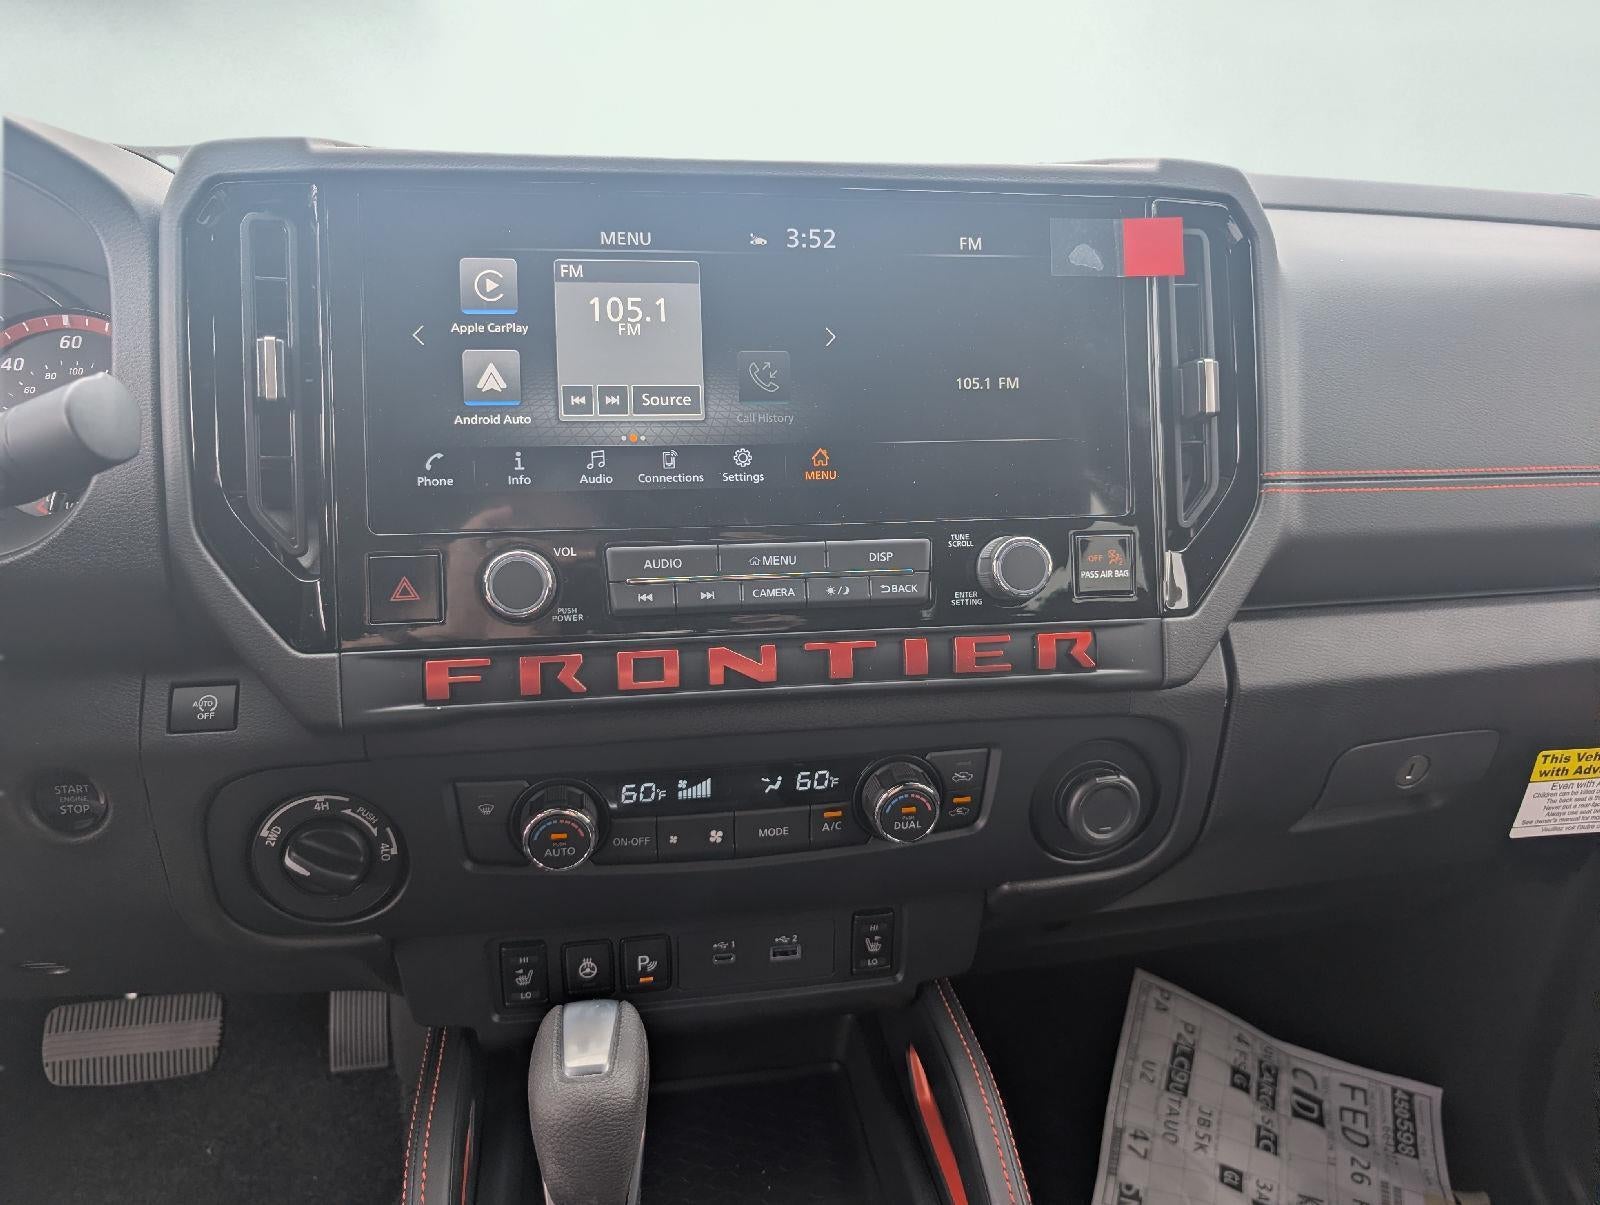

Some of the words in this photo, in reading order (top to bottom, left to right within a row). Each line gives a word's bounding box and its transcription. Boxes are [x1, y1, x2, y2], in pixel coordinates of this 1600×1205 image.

[600, 231, 652, 246] MENU
[786, 229, 837, 250] 3:52
[960, 237, 982, 251] FM
[560, 264, 584, 278] FM
[588, 296, 668, 323] 105.1
[451, 322, 485, 336] Apple
[487, 322, 529, 336] CarPlay
[618, 323, 641, 336] FM
[59, 335, 83, 349] 60
[0, 357, 25, 372] 40
[45, 372, 57, 380] 80
[69, 367, 84, 376] 100
[956, 377, 991, 390] 105.1
[998, 377, 1020, 389] FM
[641, 392, 692, 407] Source
[454, 413, 499, 426] Android
[502, 413, 532, 426] Auto
[736, 412, 756, 425] Call
[757, 412, 795, 426] History
[508, 474, 532, 485] Info
[579, 473, 614, 485] Audio
[637, 471, 704, 484] Connections
[722, 470, 765, 484] Settings
[805, 469, 837, 481] MENU
[417, 475, 454, 487] Phone
[950, 533, 970, 541] TUNE
[948, 540, 974, 548] SCROLL
[553, 547, 577, 557] VOL
[869, 552, 894, 562] DISP
[643, 558, 683, 569] AUDIO
[762, 555, 797, 566] MENU
[1088, 553, 1104, 563] OFF
[1080, 570, 1099, 579] PASS
[1100, 569, 1113, 578] AIR
[1114, 569, 1129, 578] BAG
[752, 587, 796, 598] CAMERA
[891, 584, 918, 593] BACK
[954, 591, 978, 599] ENTER
[951, 598, 983, 606] SETTING
[552, 614, 584, 622] POWER
[424, 632, 1098, 703] FRONTIER
[193, 700, 214, 708] AUTO
[197, 712, 215, 720] OFF
[1541, 754, 1571, 765] This
[1538, 767, 1569, 778] with
[54, 784, 89, 795] START
[1551, 782, 1574, 791] Even
[1576, 780, 1595, 788] with
[60, 804, 90, 815] STOP
[314, 801, 330, 811] 4H
[356, 806, 379, 824] PUSH
[821, 821, 842, 832] A/C
[894, 820, 922, 830] DUAL
[265, 825, 282, 848] 2WD
[758, 826, 790, 838] MODE
[380, 842, 391, 862] 4LO
[544, 846, 576, 857] AUTO
